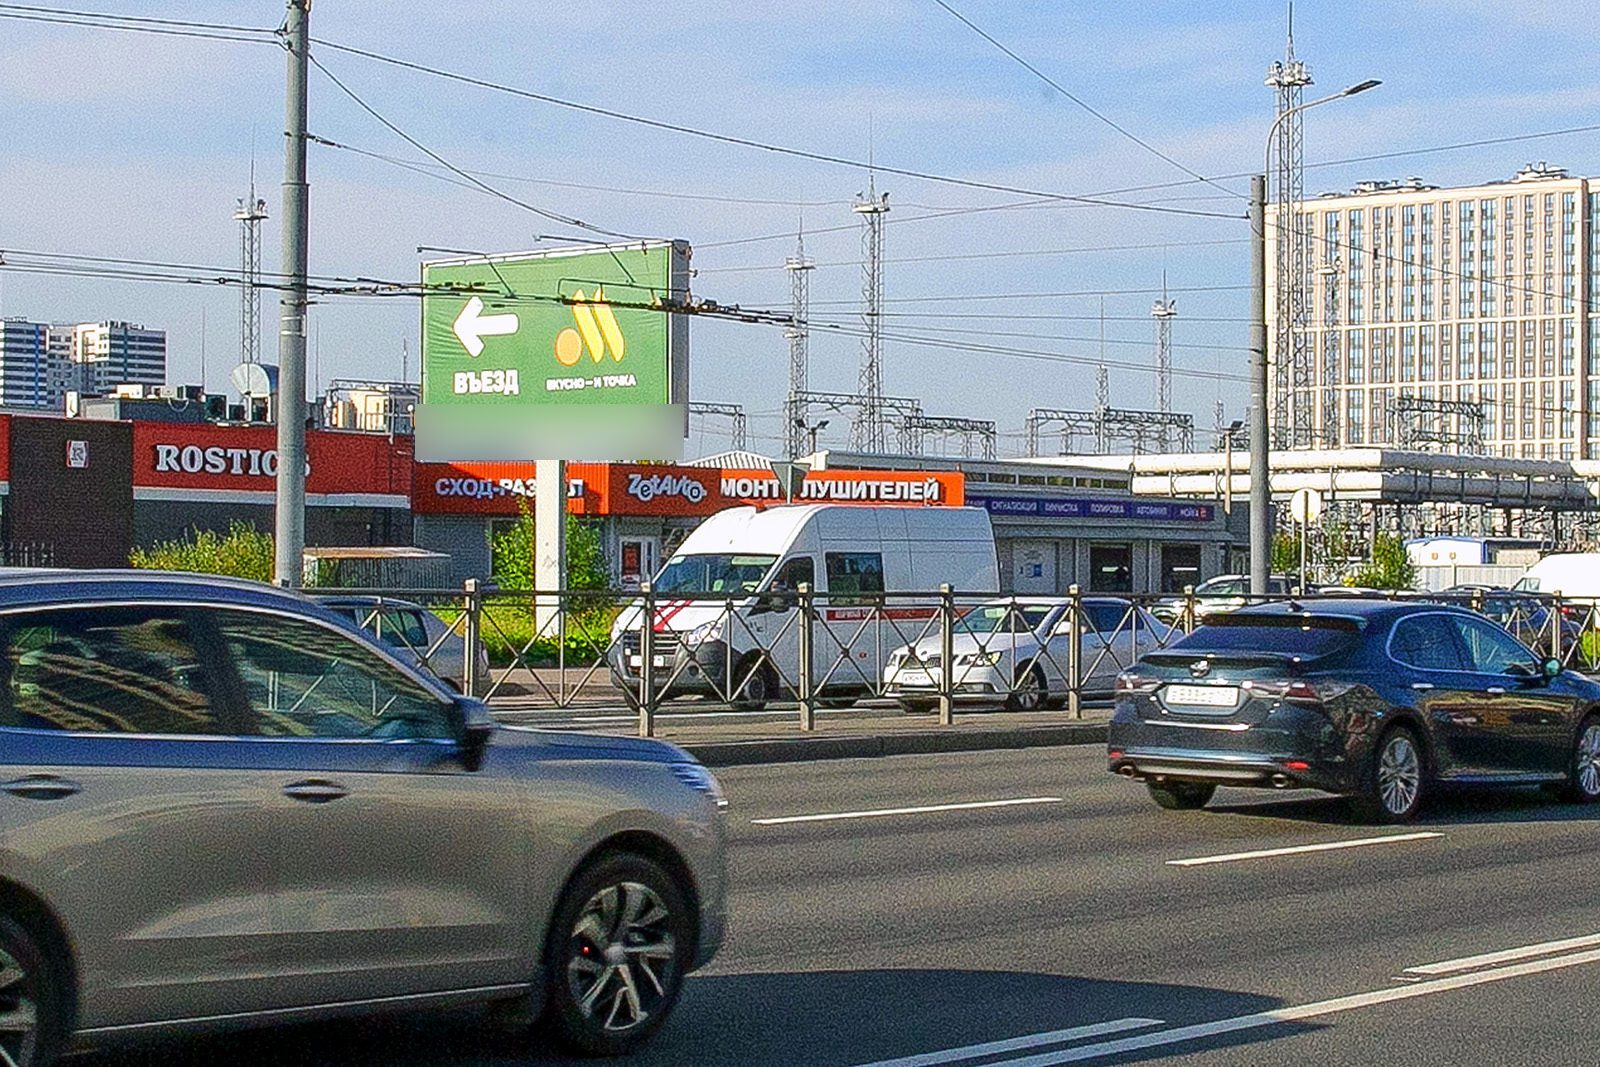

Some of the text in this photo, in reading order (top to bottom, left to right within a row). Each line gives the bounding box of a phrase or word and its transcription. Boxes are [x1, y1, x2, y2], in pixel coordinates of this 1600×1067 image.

[453, 370, 519, 396] ВЪЕЗД
[604, 374, 637, 389] ТОЧКА
[156, 444, 310, 477] ROSTIC
[435, 478, 583, 499] СХОД-РАЗЛ
[794, 478, 940, 500] ЛУШИТЕЛЕЙ
